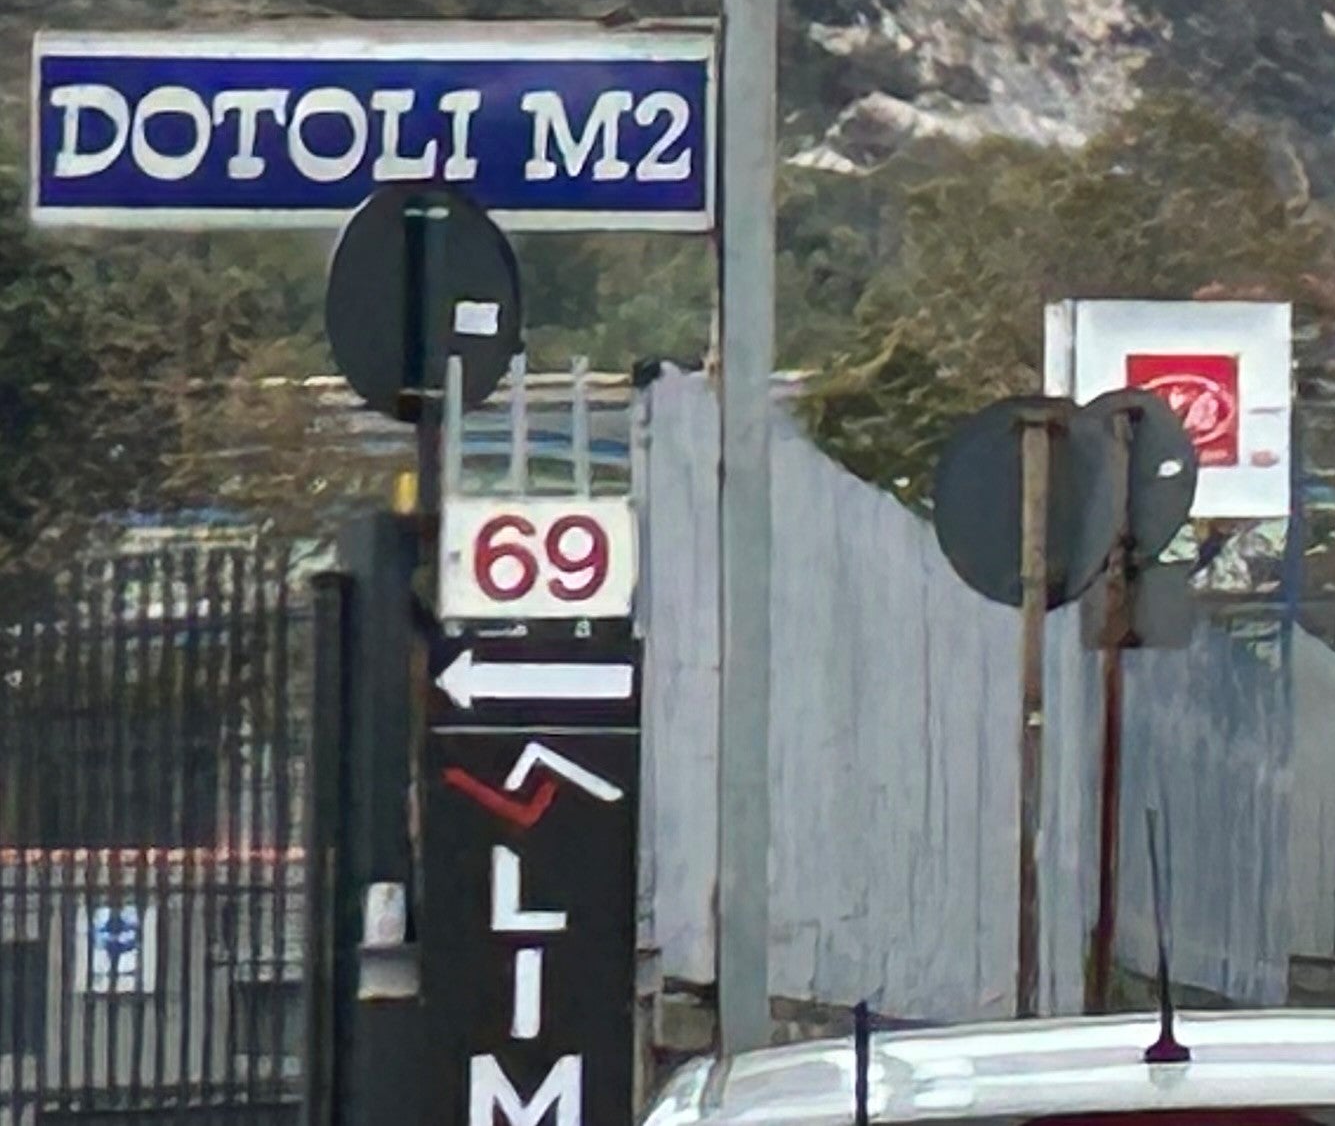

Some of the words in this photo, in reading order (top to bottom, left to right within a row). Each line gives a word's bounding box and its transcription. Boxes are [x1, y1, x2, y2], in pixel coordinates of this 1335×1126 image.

[49, 84, 481, 182] DOTOLI
[521, 90, 692, 183] M2
[473, 514, 609, 601] 69
